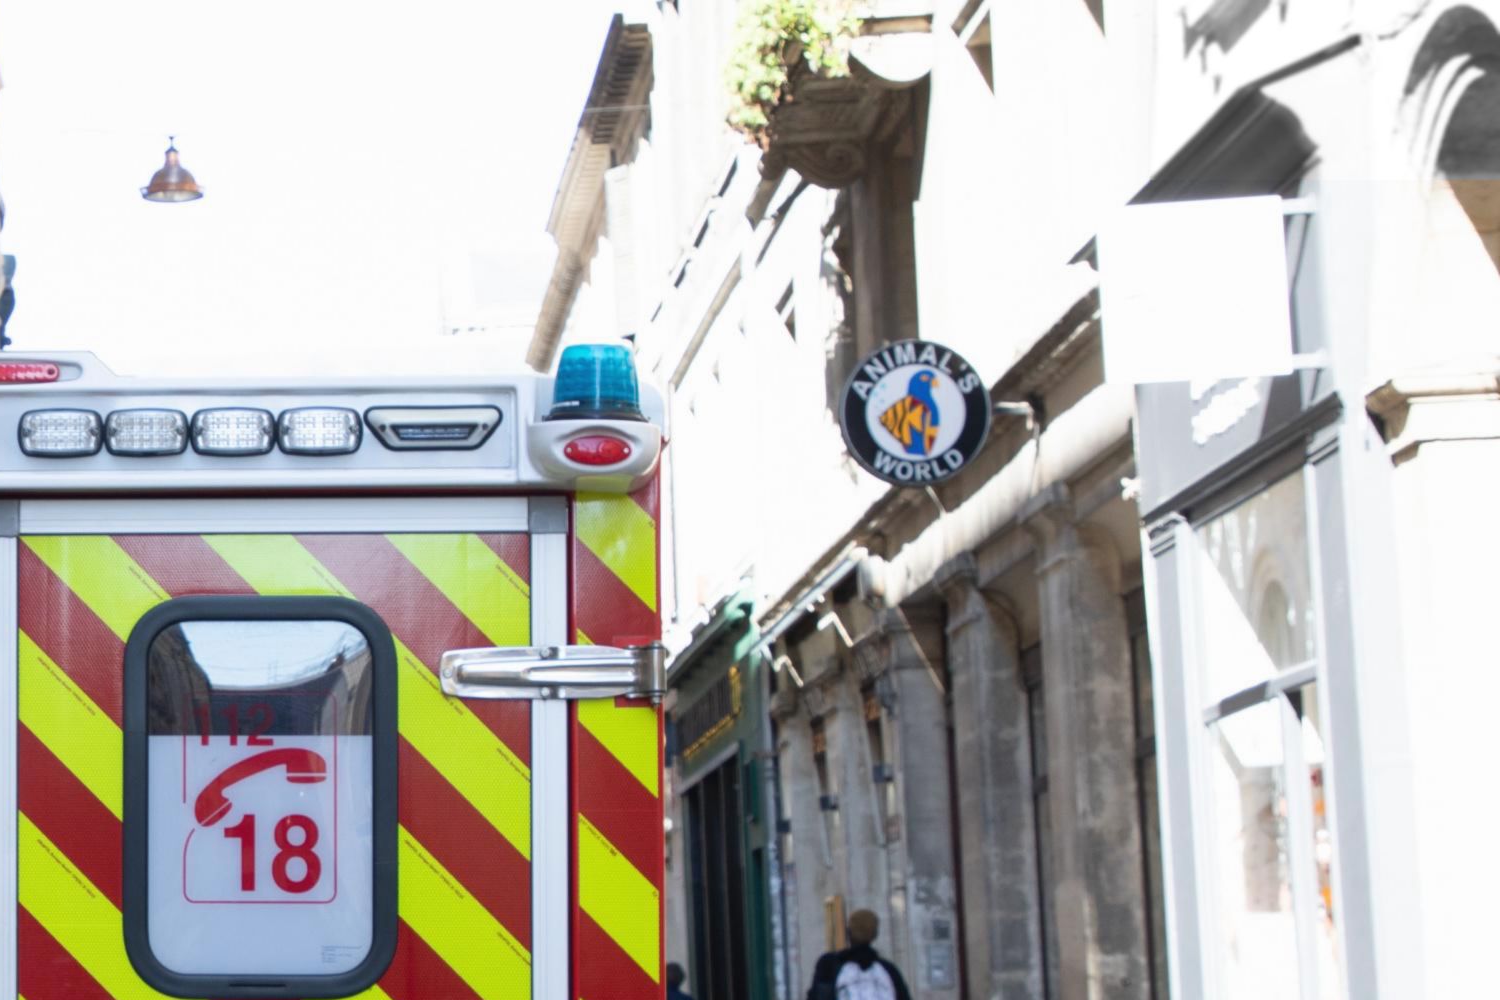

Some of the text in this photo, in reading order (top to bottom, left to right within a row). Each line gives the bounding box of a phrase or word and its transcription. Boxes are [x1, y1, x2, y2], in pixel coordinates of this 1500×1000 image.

[851, 342, 980, 400] ANIMAL'S
[873, 449, 964, 481] WORLD
[194, 703, 275, 747] 112
[224, 814, 321, 894] 18
